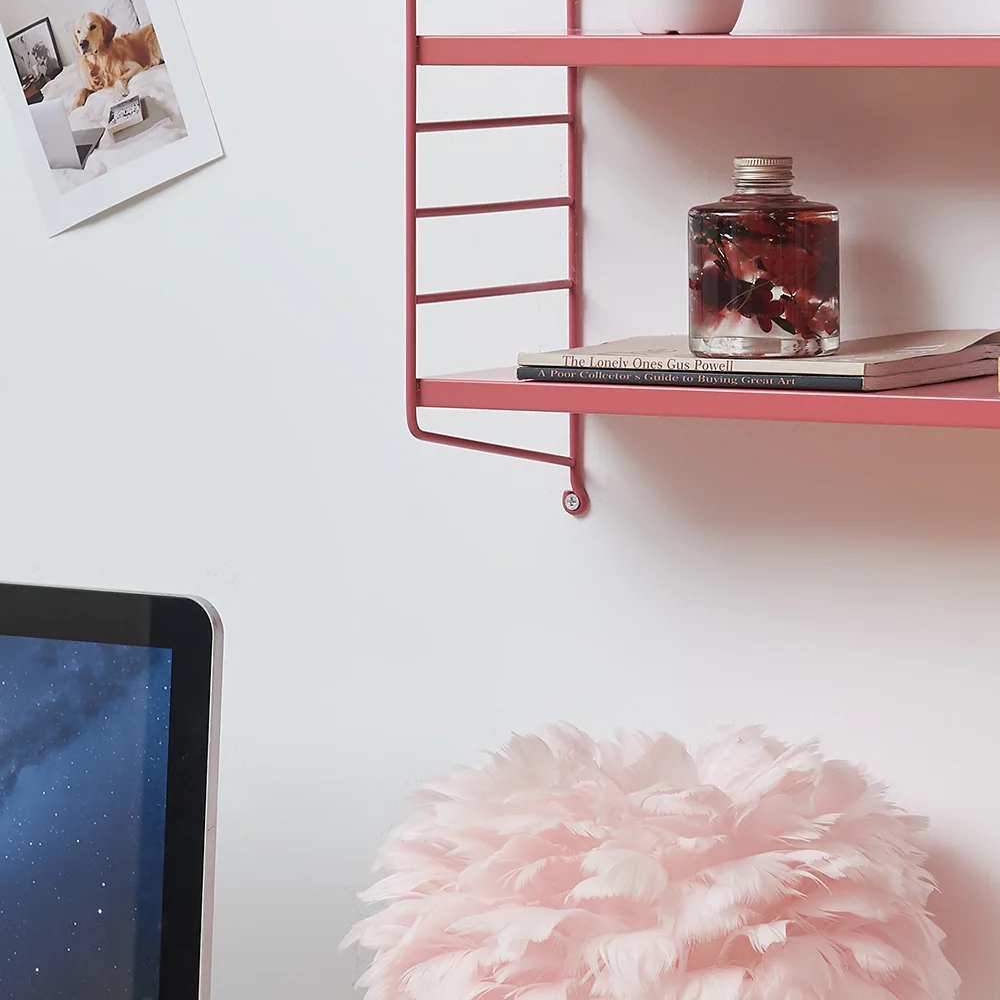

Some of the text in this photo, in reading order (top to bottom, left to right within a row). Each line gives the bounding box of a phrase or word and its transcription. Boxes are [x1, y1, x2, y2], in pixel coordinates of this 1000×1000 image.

[562, 355, 734, 372] The Lonely Ones Gus Powell
[538, 369, 546, 377] A
[550, 369, 577, 378] Poor
[644, 372, 680, 382] Guide
[682, 373, 694, 382] to
[698, 374, 738, 385] Buying
[741, 376, 774, 385] Great
[777, 377, 796, 385] Art
